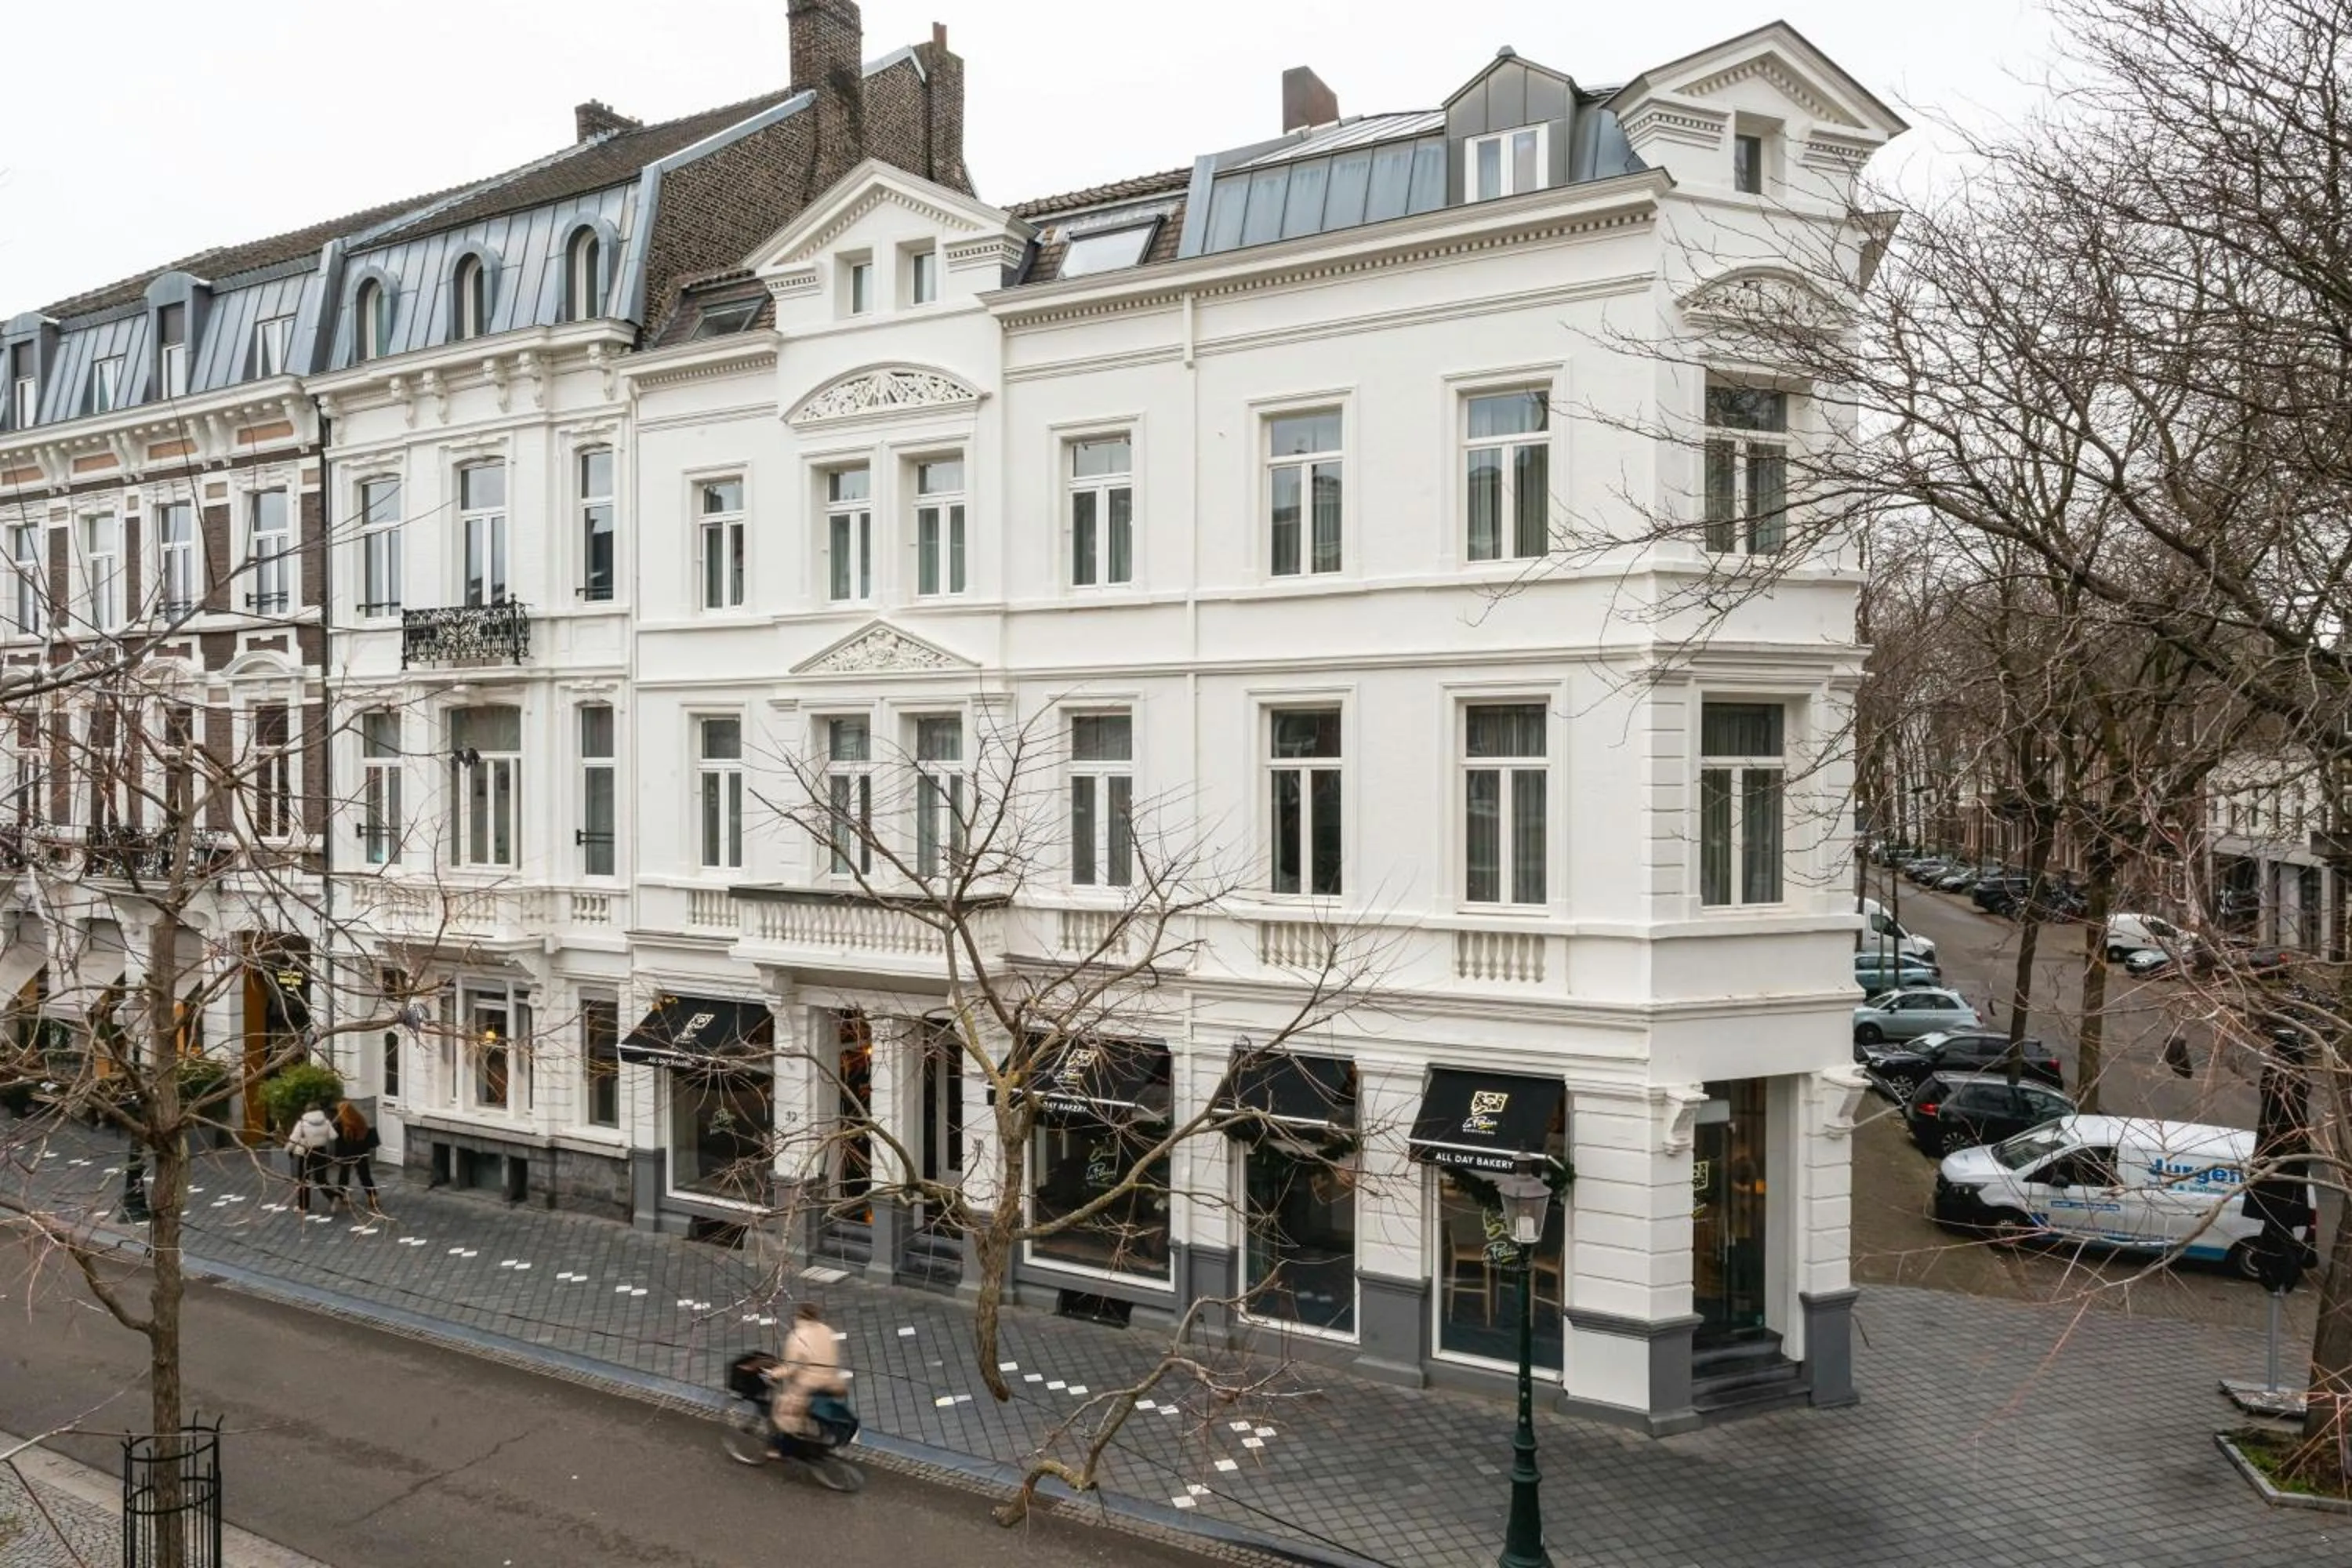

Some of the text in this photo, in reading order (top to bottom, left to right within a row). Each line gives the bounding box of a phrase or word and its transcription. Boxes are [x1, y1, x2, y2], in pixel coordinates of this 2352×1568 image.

[1436, 1152, 1514, 1169] ALL DAY BAKERY
